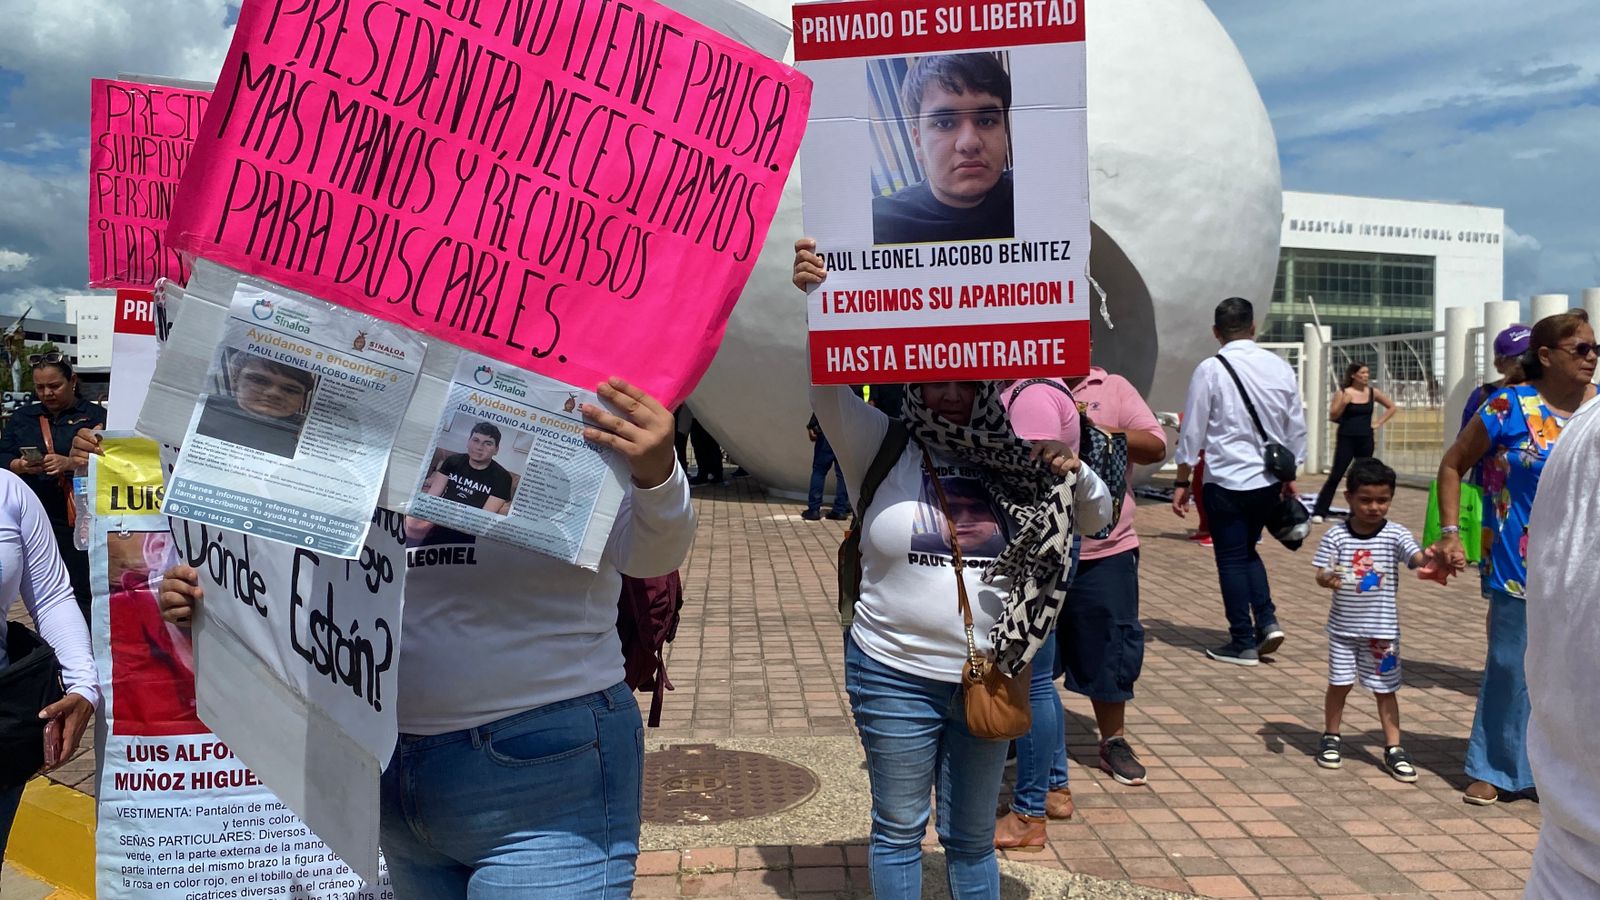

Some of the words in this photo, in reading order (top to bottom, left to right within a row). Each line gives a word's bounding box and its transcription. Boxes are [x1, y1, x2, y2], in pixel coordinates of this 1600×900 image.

[802, 12, 894, 43] PRIVADO
[901, 8, 928, 36] DE
[935, 6, 963, 34] SU
[970, 0, 1077, 32] LIBERTAD
[563, 0, 683, 115] TIENE
[673, 40, 791, 172] PAUSA.
[217, 52, 317, 165] MÁS
[307, 89, 447, 215] MANOS
[443, 148, 480, 227] Y
[473, 163, 656, 300] RECURSOS
[516, 80, 766, 262] NECESITAMOS
[213, 158, 334, 277] PARA
[1360, 223, 1452, 241] INTERNATIONAL
[1458, 231, 1499, 244] CENTER
[862, 248, 924, 270] LEONEL
[929, 244, 993, 267] JACOBO
[999, 240, 1071, 264] BENITEZ
[834, 287, 924, 314] EXIGIMOS
[929, 286, 953, 310] SU
[959, 281, 1062, 308] APARICION
[274, 315, 311, 335] Sinaloa
[246, 327, 312, 357] Ayúdanos
[315, 351, 324, 360] a
[326, 354, 389, 380] encontrar
[390, 373, 399, 383] a
[368, 342, 406, 358] SINALOA
[826, 345, 898, 372] HASTA
[904, 338, 1065, 371] ENCONTRARTE
[247, 343, 273, 358] PAUL
[274, 351, 309, 369] LEONEL
[310, 362, 348, 380] JACOBO
[349, 375, 387, 393] BENITEZ
[492, 380, 527, 398] Sinaloa
[468, 391, 528, 418] Ayúdanos
[530, 411, 538, 421] a
[457, 402, 477, 416] JOEL
[478, 409, 519, 428] ANTONIO
[519, 421, 560, 440] ALAPIZCO
[560, 434, 604, 455] CARDENAS
[448, 472, 492, 495] BALMAIN
[174, 489, 197, 500] llama
[252, 507, 262, 515] Tu
[263, 511, 287, 521] ayuda
[298, 519, 316, 530] muy
[177, 480, 186, 488] Si
[189, 484, 213, 496] tienes
[215, 490, 263, 507] información
[265, 502, 300, 516] referente
[310, 513, 327, 523] esta
[407, 546, 477, 568] LEONEL
[908, 552, 947, 567] PAUL
[126, 744, 169, 762] LUIS
[175, 742, 235, 762] ALFO
[114, 769, 185, 792] MUÑOZ
[191, 769, 264, 790] HIGUE
[116, 806, 192, 819] VESTIMENTA:
[195, 804, 244, 817] Pantalón
[248, 802, 262, 813] de
[222, 820, 229, 832] y
[232, 817, 266, 829] tennis
[269, 814, 296, 826] color
[119, 834, 156, 848] SEÑAS
[158, 831, 256, 847] PARTICULARES:
[259, 828, 306, 840] Diversos
[126, 851, 155, 863] verde,
[158, 851, 172, 861] en
[175, 850, 185, 861] la
[188, 849, 217, 862] parte
[220, 846, 261, 858] externa
[264, 843, 278, 854] de
[281, 842, 291, 852] la
[294, 840, 325, 852] mano
[121, 866, 145, 876] parte
[147, 864, 185, 876] interna
[188, 863, 205, 874] del
[208, 861, 245, 873] mismo
[247, 858, 279, 870] brazo
[281, 856, 291, 866] la
[294, 854, 325, 867] figura
[122, 878, 131, 888] la
[133, 879, 153, 890] rosa
[156, 880, 170, 890] en
[173, 877, 201, 889] color
[231, 874, 247, 884] en
[249, 872, 258, 883] el
[261, 869, 293, 882] tobillo
[295, 868, 310, 879] de
[312, 865, 333, 876] una
[335, 863, 349, 874] de
[186, 890, 238, 900] cicatrices
[240, 885, 287, 897] diversas
[289, 883, 303, 893] en
[305, 880, 316, 892] el
[318, 878, 355, 890] cráneo
[358, 878, 365, 889] y
